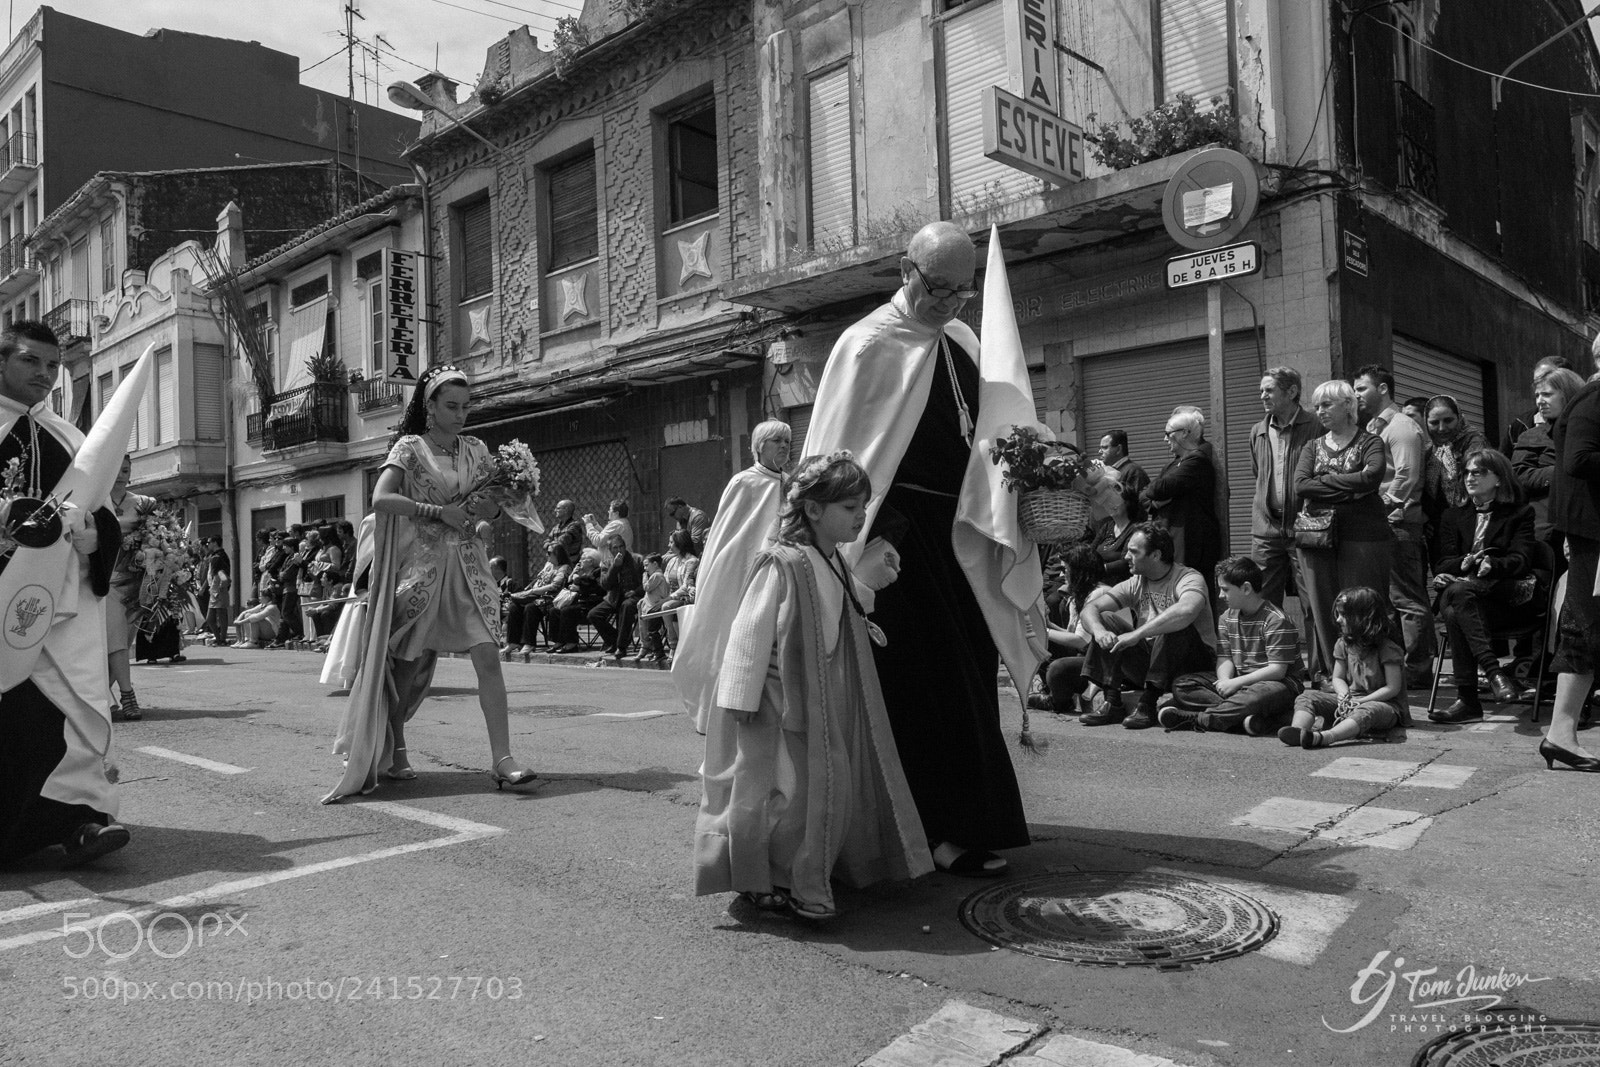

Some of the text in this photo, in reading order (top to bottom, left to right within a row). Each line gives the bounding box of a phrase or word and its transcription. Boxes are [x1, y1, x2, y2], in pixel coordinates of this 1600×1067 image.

[998, 97, 1082, 178] ESTEVE
[1173, 272, 1188, 284] DE
[1194, 270, 1202, 279] 8
[1208, 267, 1217, 277] A
[1223, 263, 1236, 273] 15
[1190, 250, 1235, 269] JUEVES
[389, 251, 416, 380] FERRETERIA
